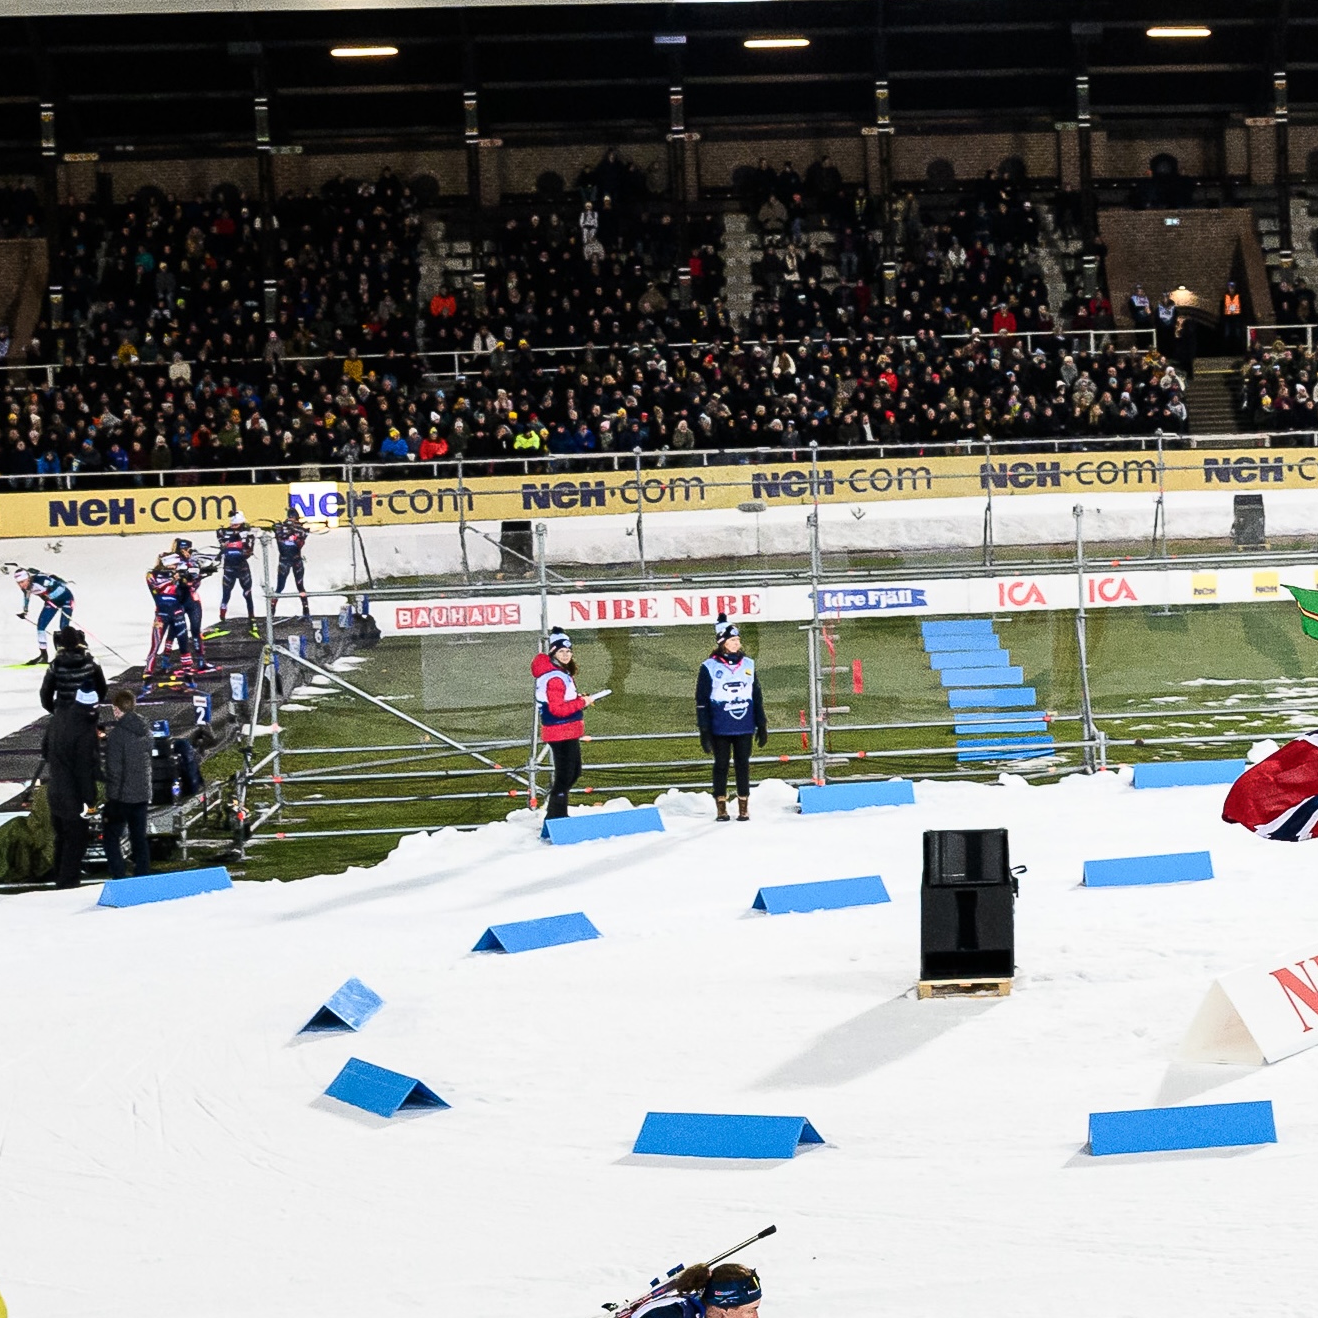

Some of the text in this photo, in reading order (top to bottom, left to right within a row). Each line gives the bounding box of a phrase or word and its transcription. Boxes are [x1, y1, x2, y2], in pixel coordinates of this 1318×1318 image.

[998, 577, 1138, 606] ICA ICA
[397, 604, 520, 628] BAUHAUS
[570, 594, 761, 622] NIBE NIBE
[195, 706, 207, 725] 2
